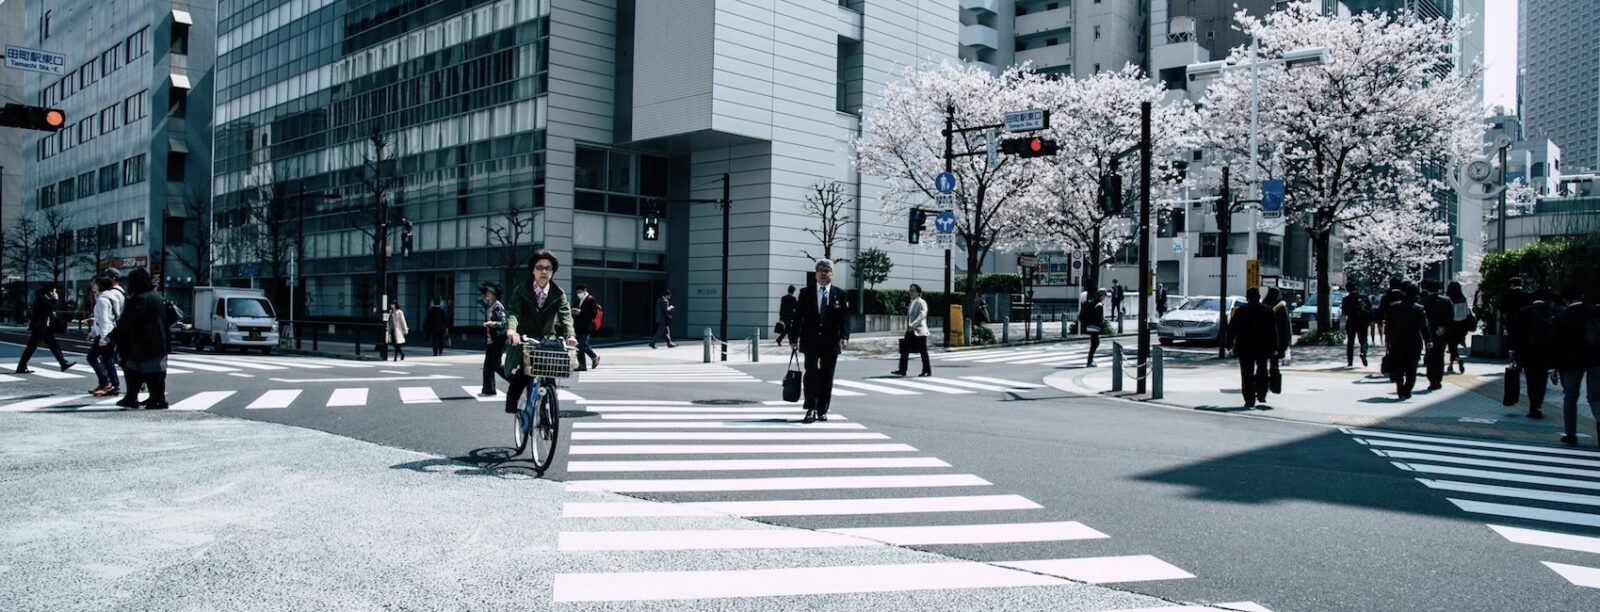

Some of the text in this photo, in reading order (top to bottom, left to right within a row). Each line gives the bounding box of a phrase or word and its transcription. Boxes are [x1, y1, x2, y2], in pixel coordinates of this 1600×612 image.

[8, 48, 64, 66] 田町駅東口
[11, 60, 37, 69] Tamachi
